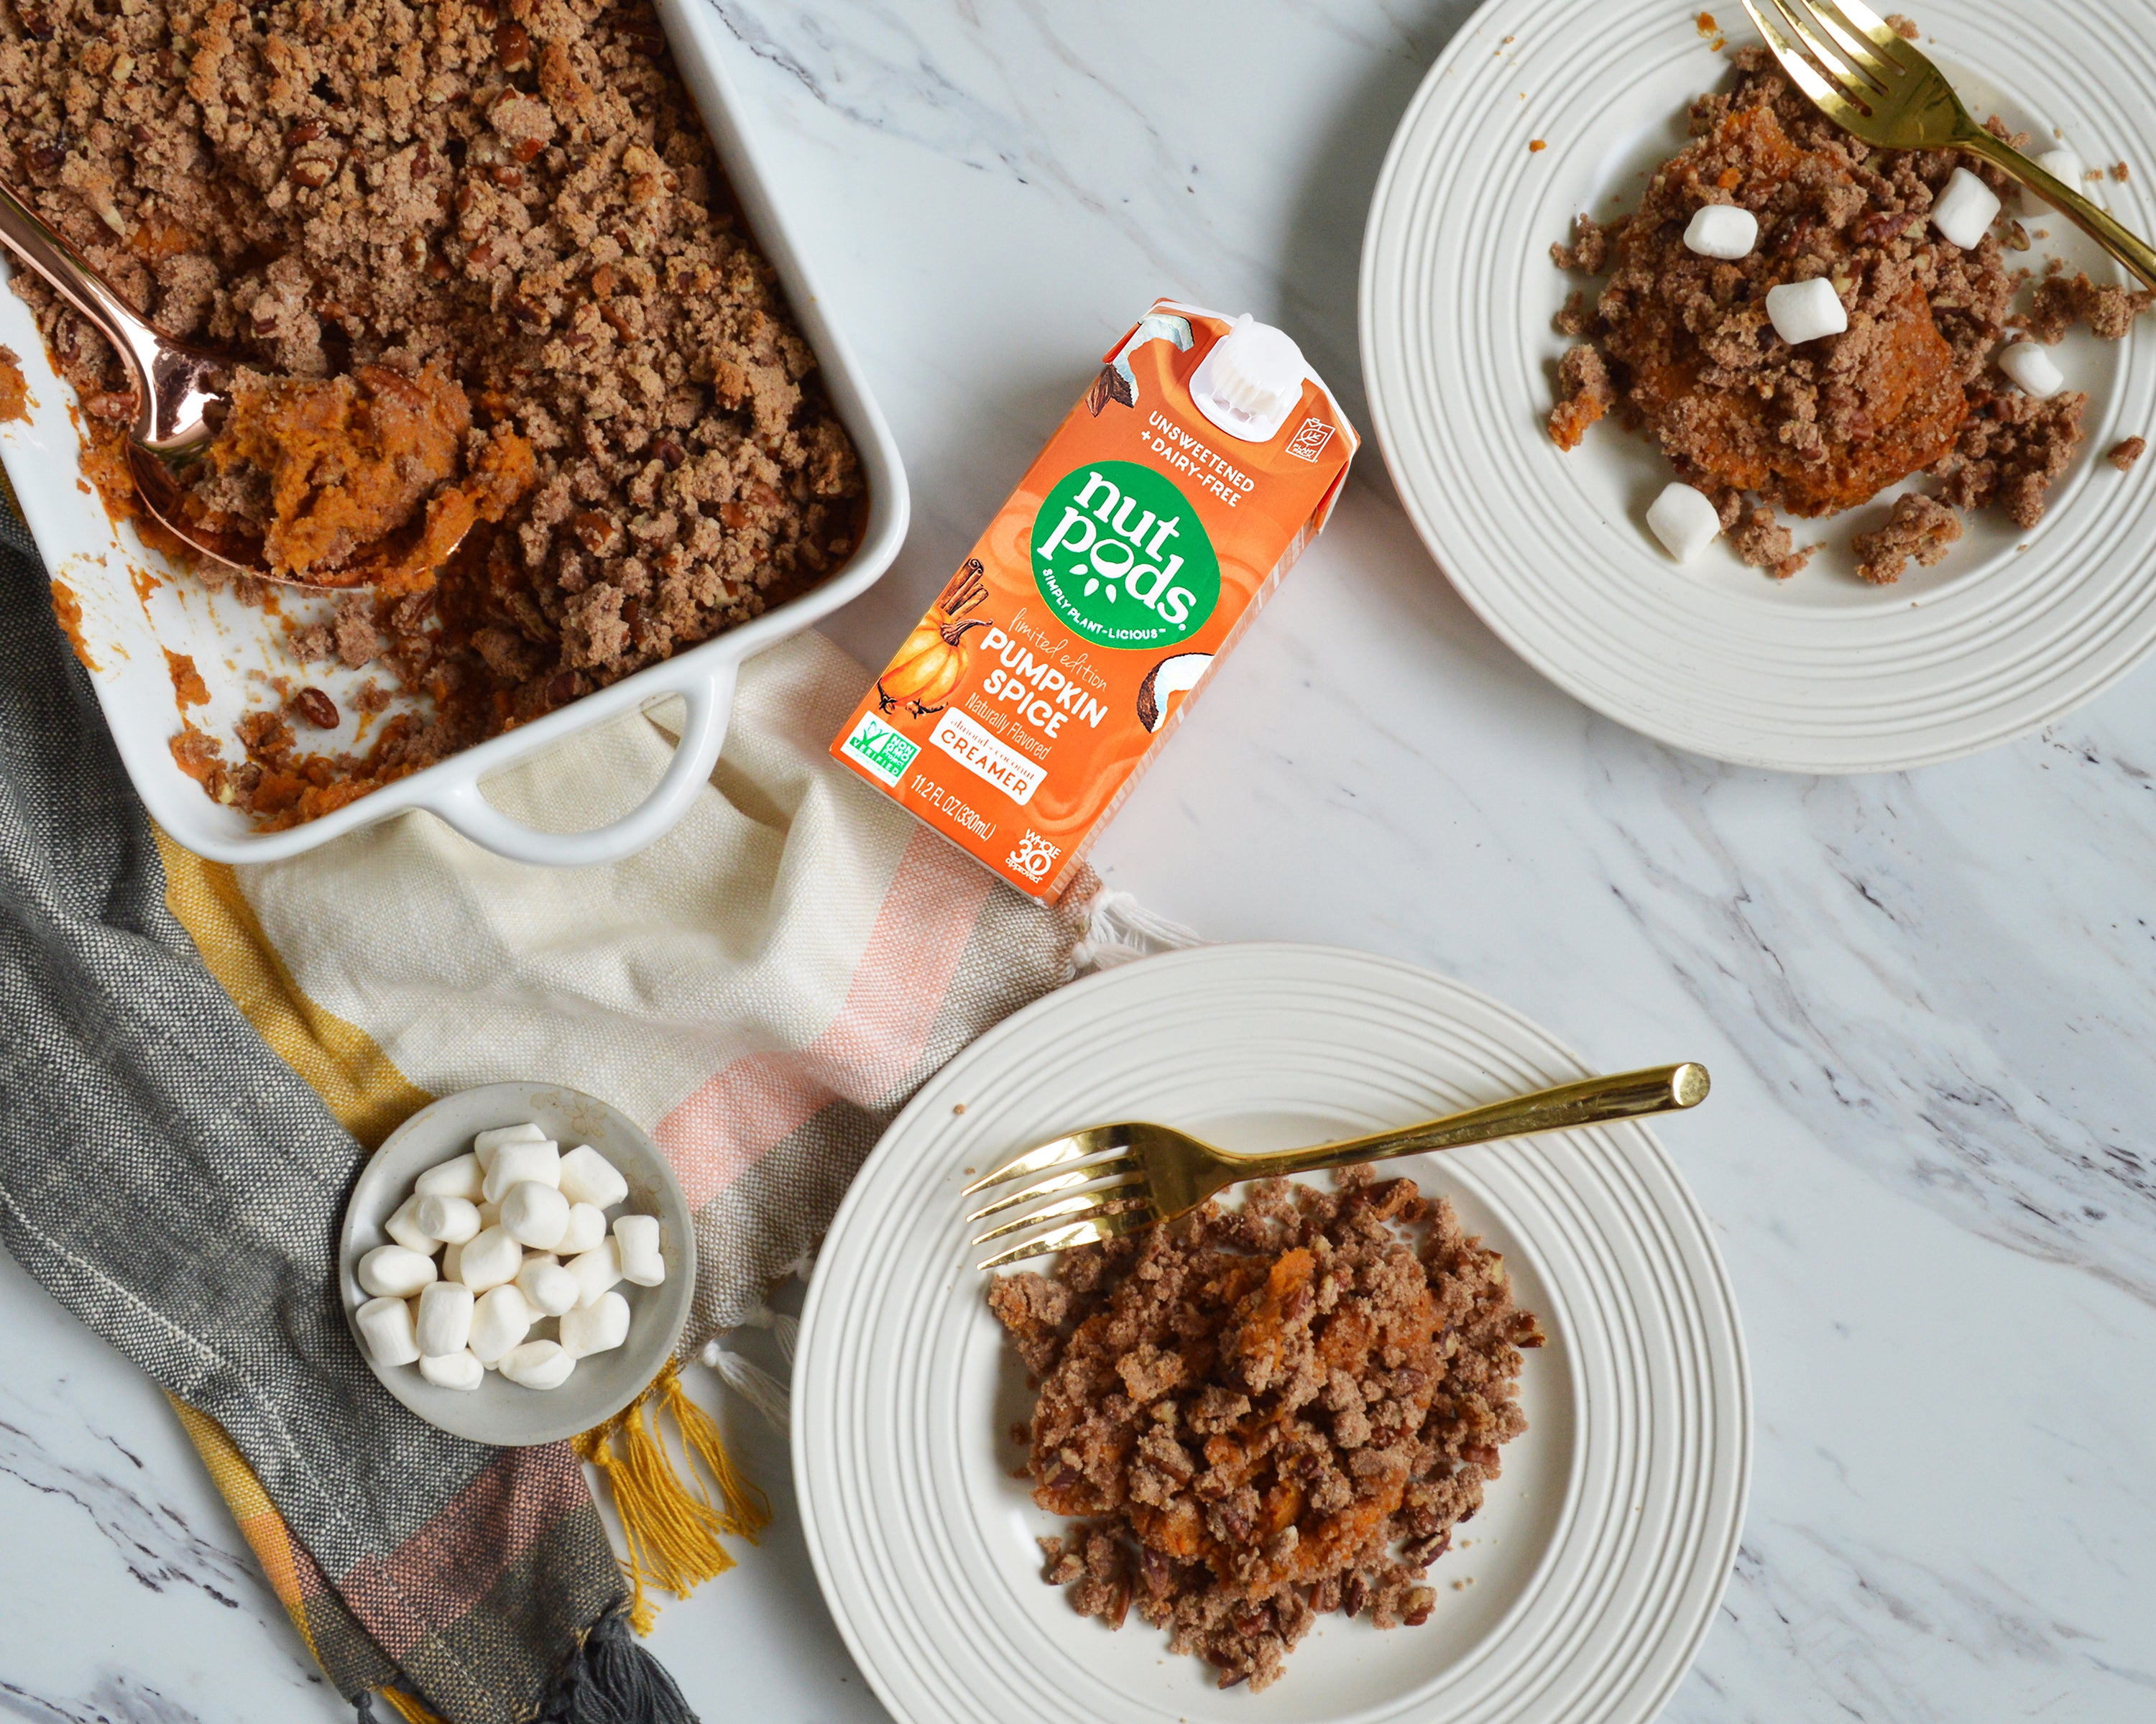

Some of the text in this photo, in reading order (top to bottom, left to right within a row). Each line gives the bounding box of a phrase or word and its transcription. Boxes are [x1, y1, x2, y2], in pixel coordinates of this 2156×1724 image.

[1149, 410, 1255, 492] UNSWEETENED
[1151, 438, 1242, 507] DAIRY-FREE
[1292, 448, 1312, 458] PACK
[1293, 443, 1317, 455] PLANT
[1073, 471, 1180, 563] nut
[1036, 506, 1197, 624] pods
[1043, 568, 1071, 609] SIMPLY
[980, 627, 1108, 729] PUMPKIN
[1008, 607, 1107, 692] limited edition
[964, 692, 1051, 760] Naturally Flavored
[983, 669, 1069, 739] SPICE
[852, 739, 899, 775] VERIFIED
[882, 748, 905, 767] Project
[886, 742, 909, 762] GMO
[891, 735, 914, 755] NON
[941, 729, 1028, 796] CREAMER
[950, 720, 989, 747] almond
[995, 750, 1035, 780] coconut
[911, 774, 997, 842] 11.2 FL OZ (330mL)
[1010, 839, 1051, 875] 30
[1025, 828, 1061, 859] WHOLE
